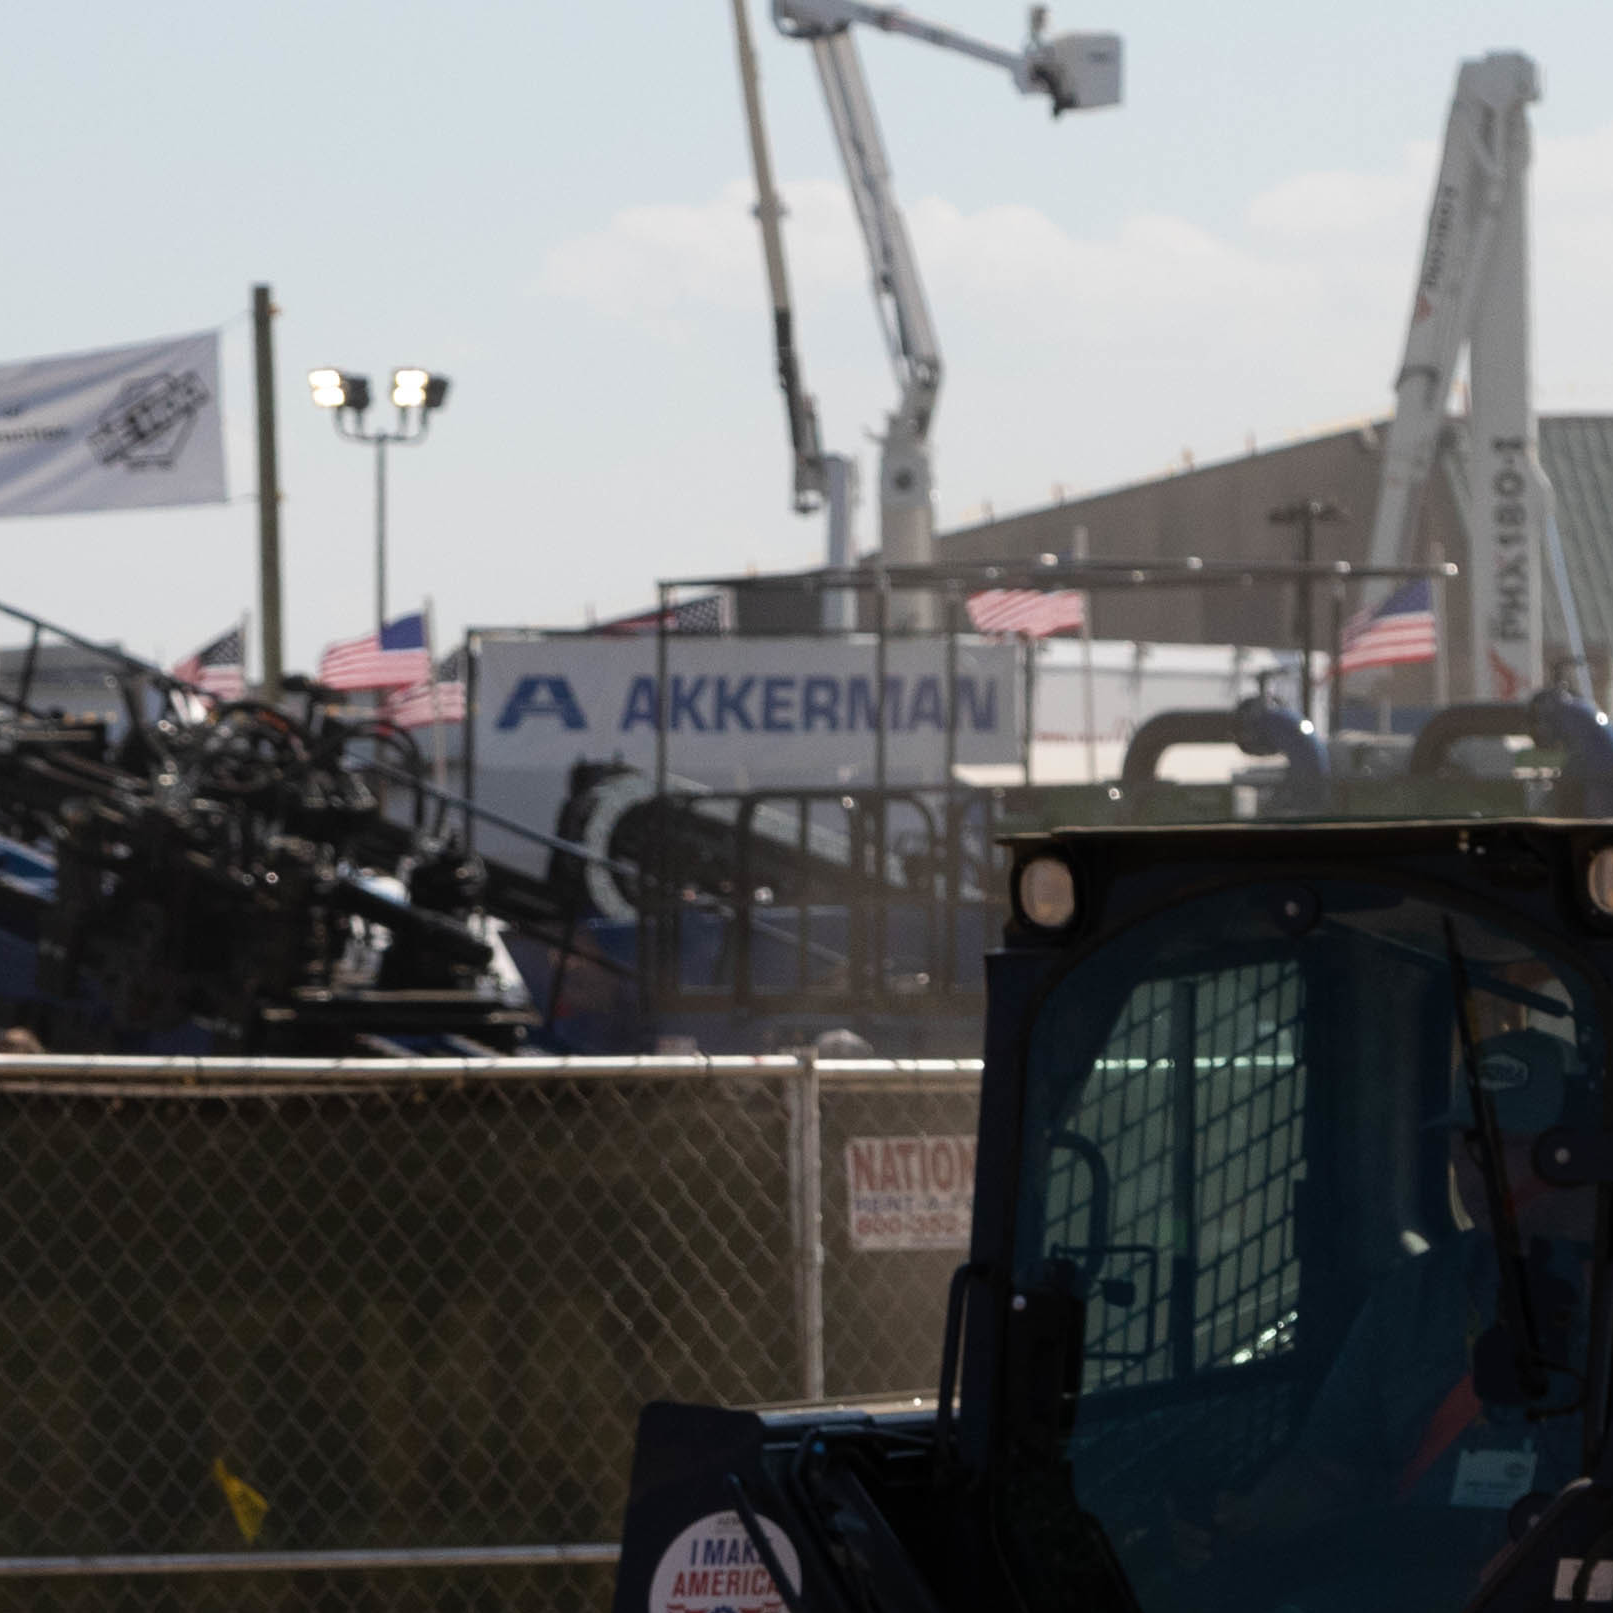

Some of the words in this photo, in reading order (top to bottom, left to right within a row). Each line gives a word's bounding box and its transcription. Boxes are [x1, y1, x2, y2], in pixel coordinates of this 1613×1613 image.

[617, 672, 999, 733] AKKERMAN
[690, 1538, 700, 1567] I
[703, 1537, 766, 1566] MAK
